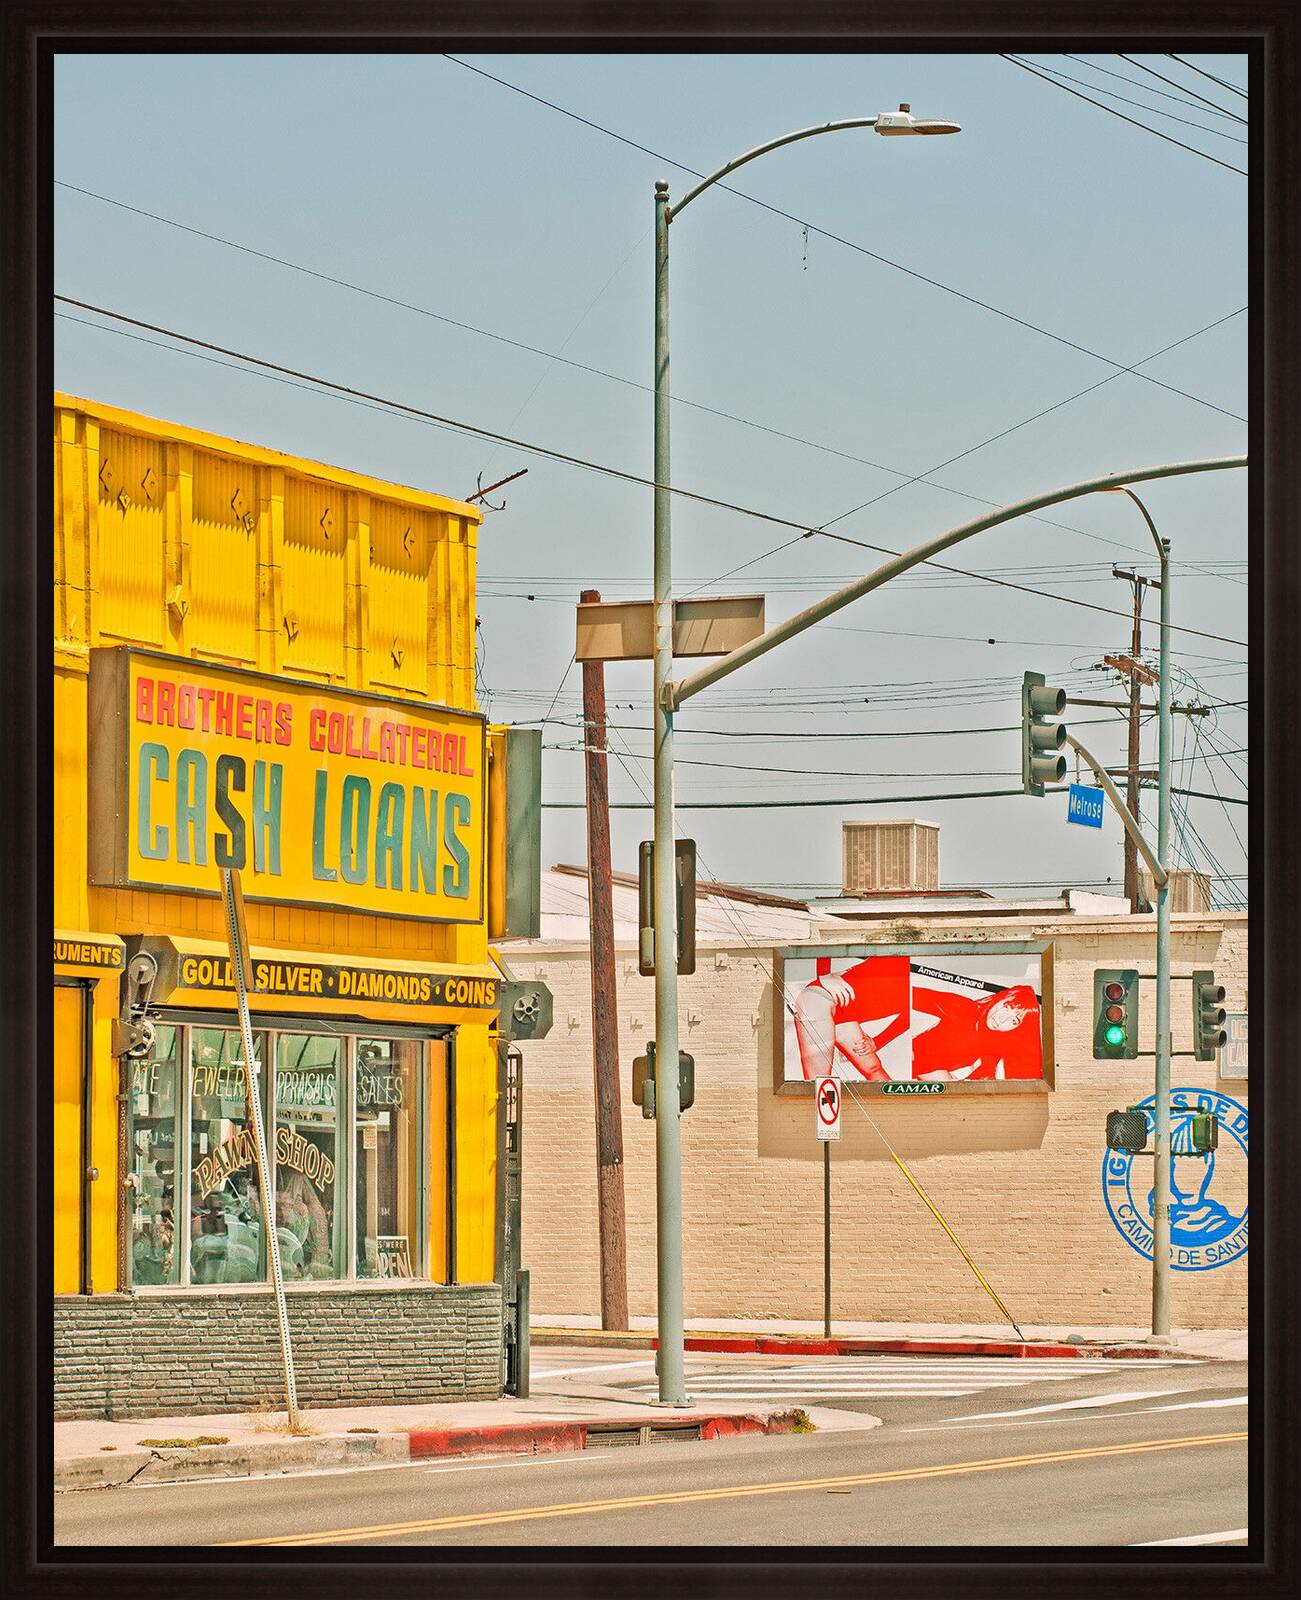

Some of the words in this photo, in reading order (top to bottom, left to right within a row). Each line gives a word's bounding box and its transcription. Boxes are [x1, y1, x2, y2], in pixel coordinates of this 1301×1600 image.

[137, 677, 292, 746] BROTHERS
[309, 709, 474, 777] COLLATERAL
[138, 742, 283, 876] CASH
[313, 768, 471, 899] LOANS
[1070, 793, 1102, 819] Melrose
[255, 964, 323, 994] SILVER
[338, 970, 431, 1002] DIAMONDS
[444, 980, 497, 1006] COINS
[917, 966, 954, 982] American
[954, 975, 985, 989] Apparel
[359, 1075, 403, 1105] SALES
[887, 1083, 941, 1094] LAMAR
[275, 1127, 336, 1193] SHOP
[1178, 1249, 1201, 1265] DE
